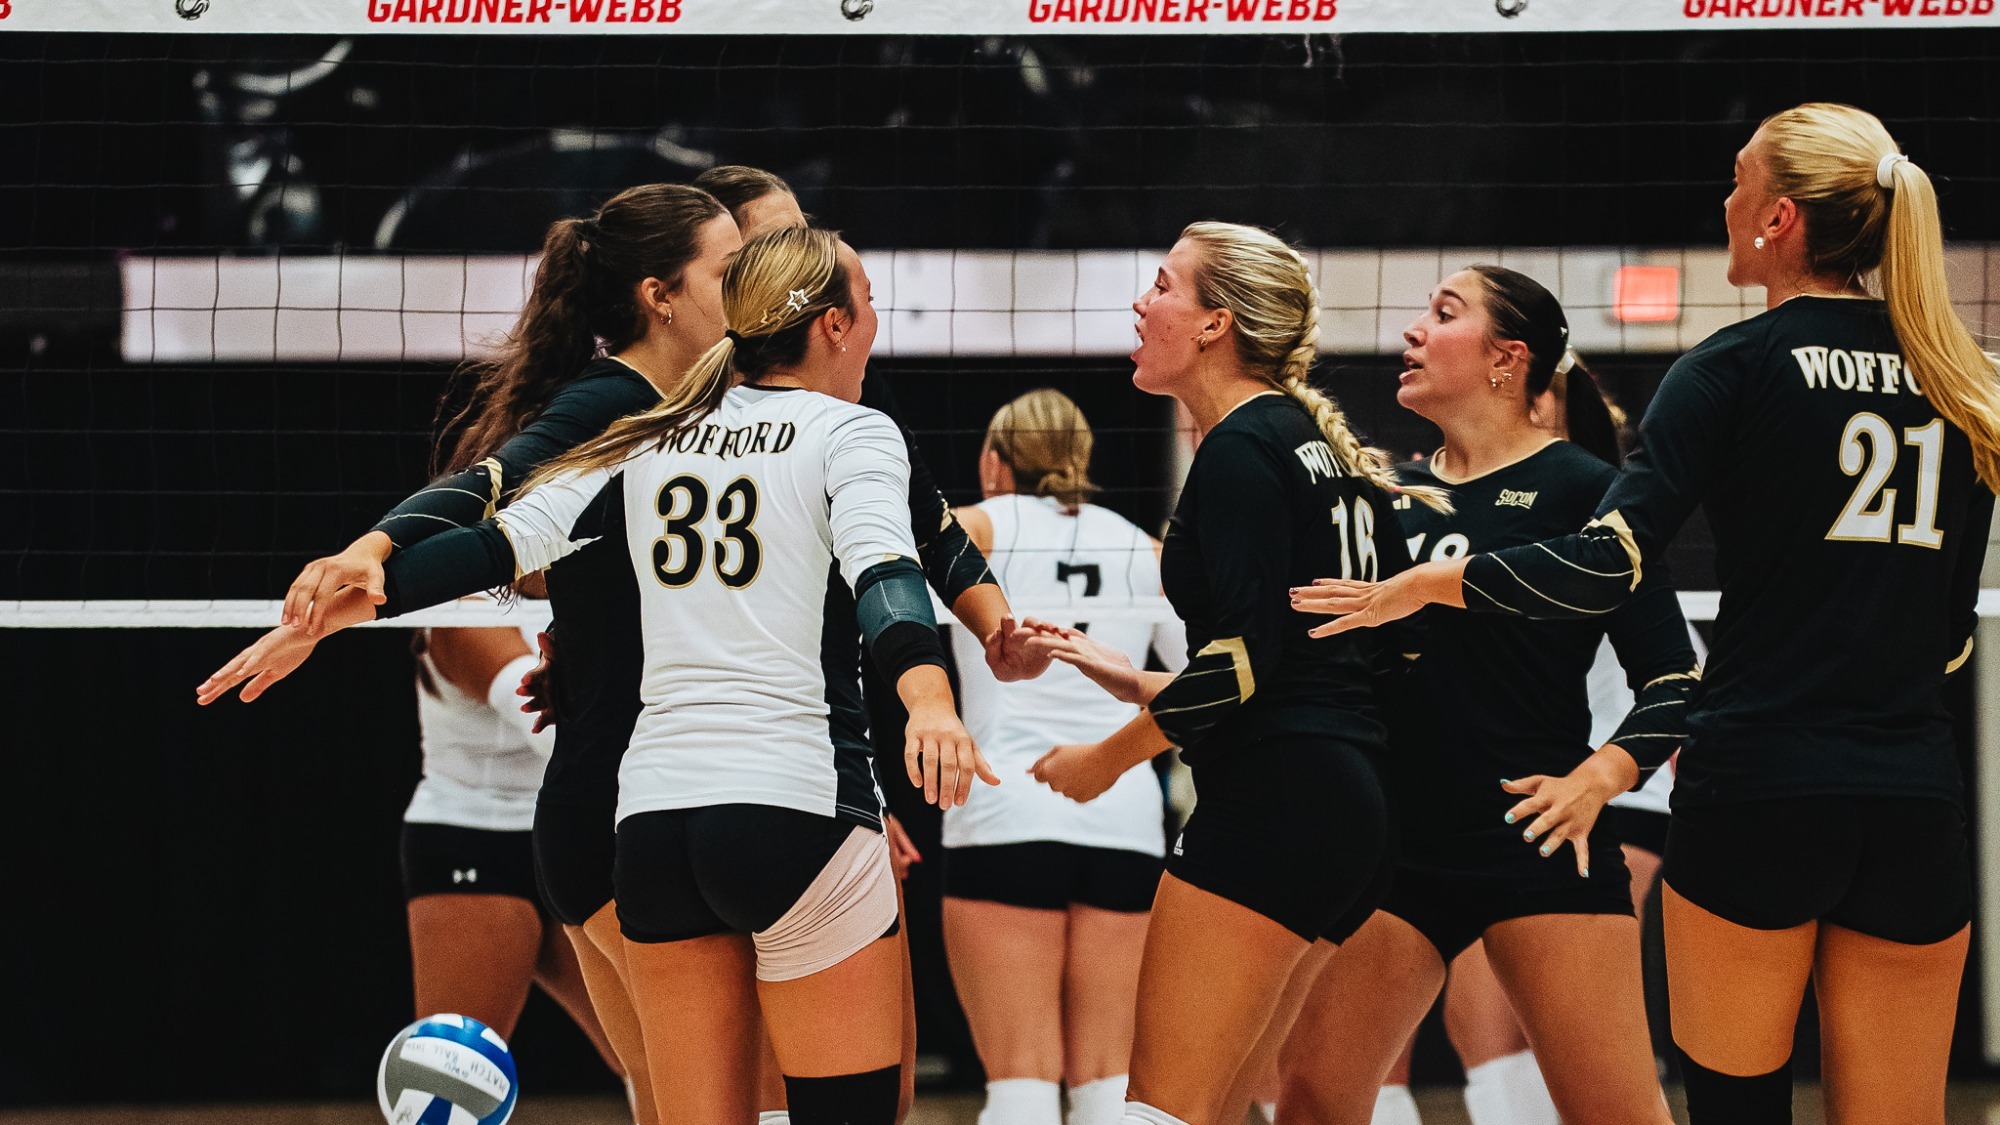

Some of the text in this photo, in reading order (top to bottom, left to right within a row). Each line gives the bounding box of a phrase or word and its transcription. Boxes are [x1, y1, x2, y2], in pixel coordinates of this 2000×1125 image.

[367, 0, 684, 23] GARDNER-WEBB
[1028, 0, 1338, 23] GARDNER-WEBB
[657, 421, 796, 461] WOFFORD
[1494, 488, 1539, 510] SOCON
[1824, 411, 1945, 550] 21
[651, 472, 764, 590] 33
[1330, 495, 1379, 583] 16
